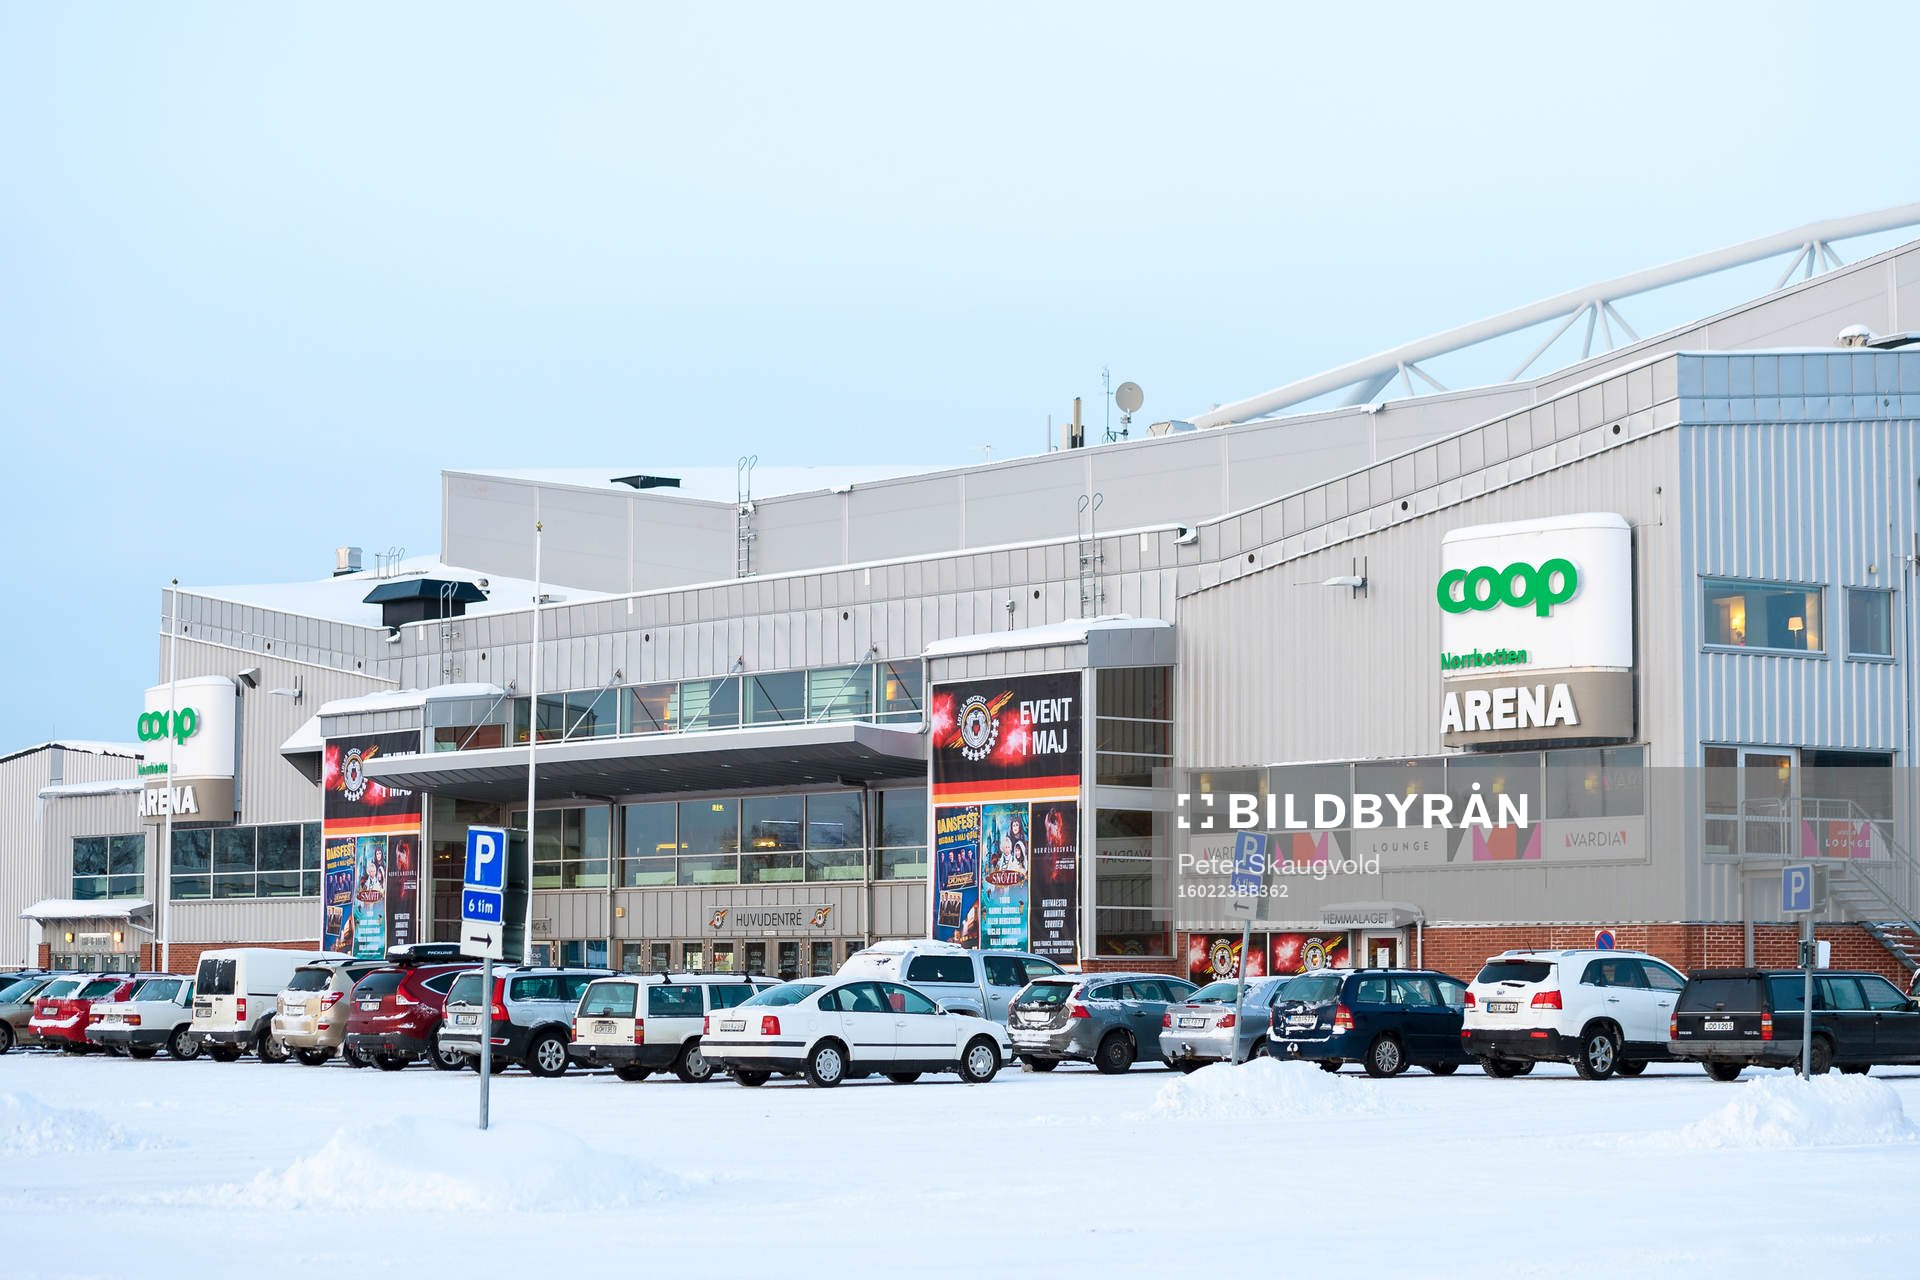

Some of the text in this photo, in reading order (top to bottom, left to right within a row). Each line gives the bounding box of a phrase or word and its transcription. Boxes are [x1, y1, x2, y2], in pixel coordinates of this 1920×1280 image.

[1437, 558, 1578, 617] coop
[1441, 649, 1528, 671] Norrbotten
[1020, 697, 1072, 725] EVENT
[1440, 683, 1580, 734] ARENA
[138, 707, 196, 745] coop
[1032, 729, 1068, 755] MAJ
[138, 785, 197, 817] ARENA
[1242, 835, 1258, 866] P
[1373, 841, 1429, 852] LOUNGE
[1569, 831, 1620, 848] VARDIA
[1826, 839, 1871, 848] LOUNGE
[475, 834, 495, 881] P
[1791, 871, 1804, 907] P
[468, 899, 493, 914] 6 tim
[736, 909, 802, 927] HUVUDENTRÉ
[1324, 912, 1388, 925] HEMMALAGET
